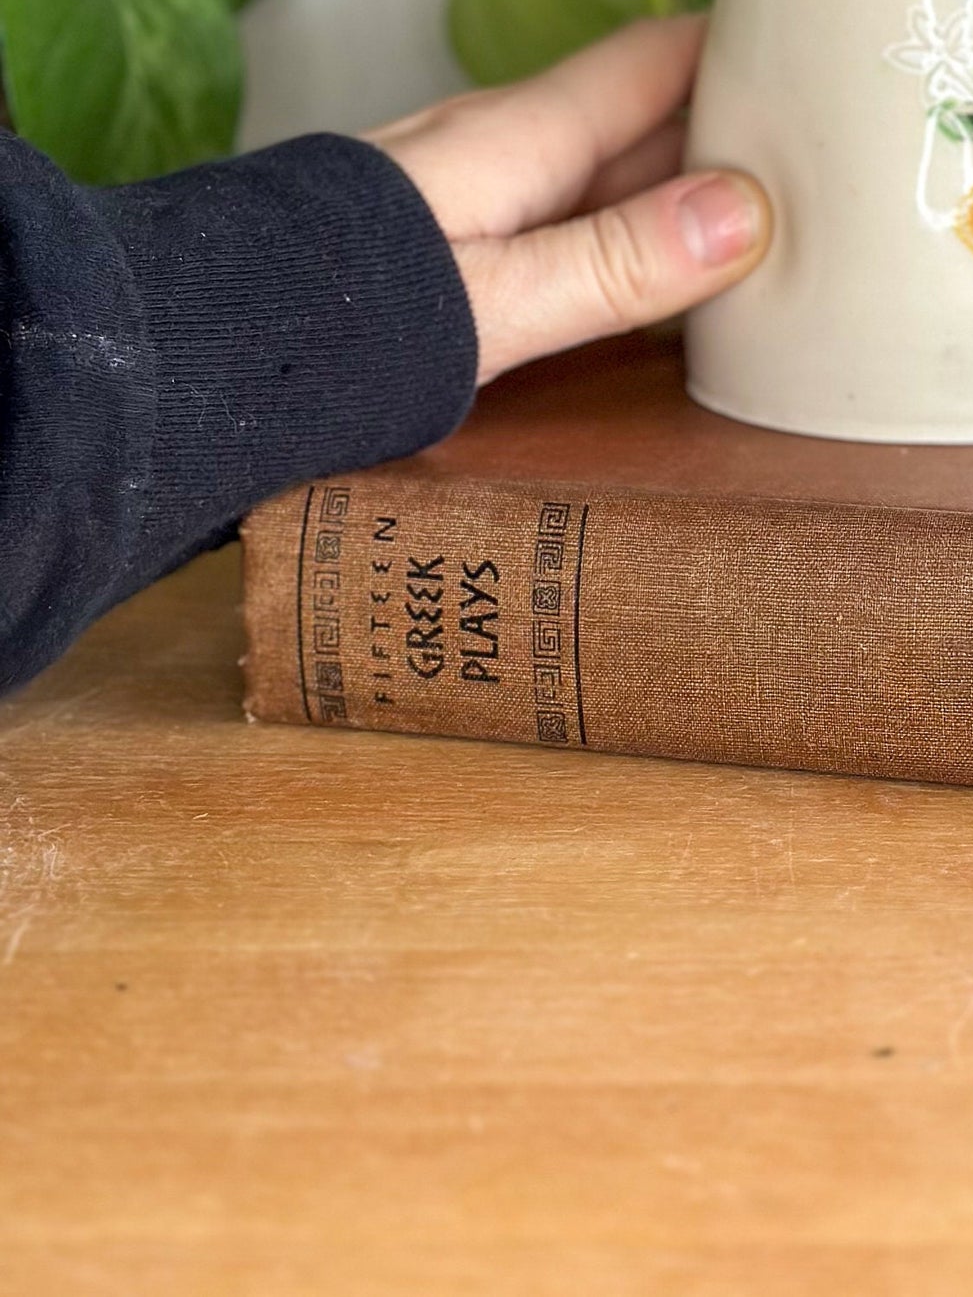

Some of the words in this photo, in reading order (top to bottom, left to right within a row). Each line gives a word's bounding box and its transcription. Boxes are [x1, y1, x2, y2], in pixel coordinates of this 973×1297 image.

[371, 517, 397, 705] FIFTEEN
[405, 555, 445, 680] GREEK
[459, 559, 500, 683] PLAYS
